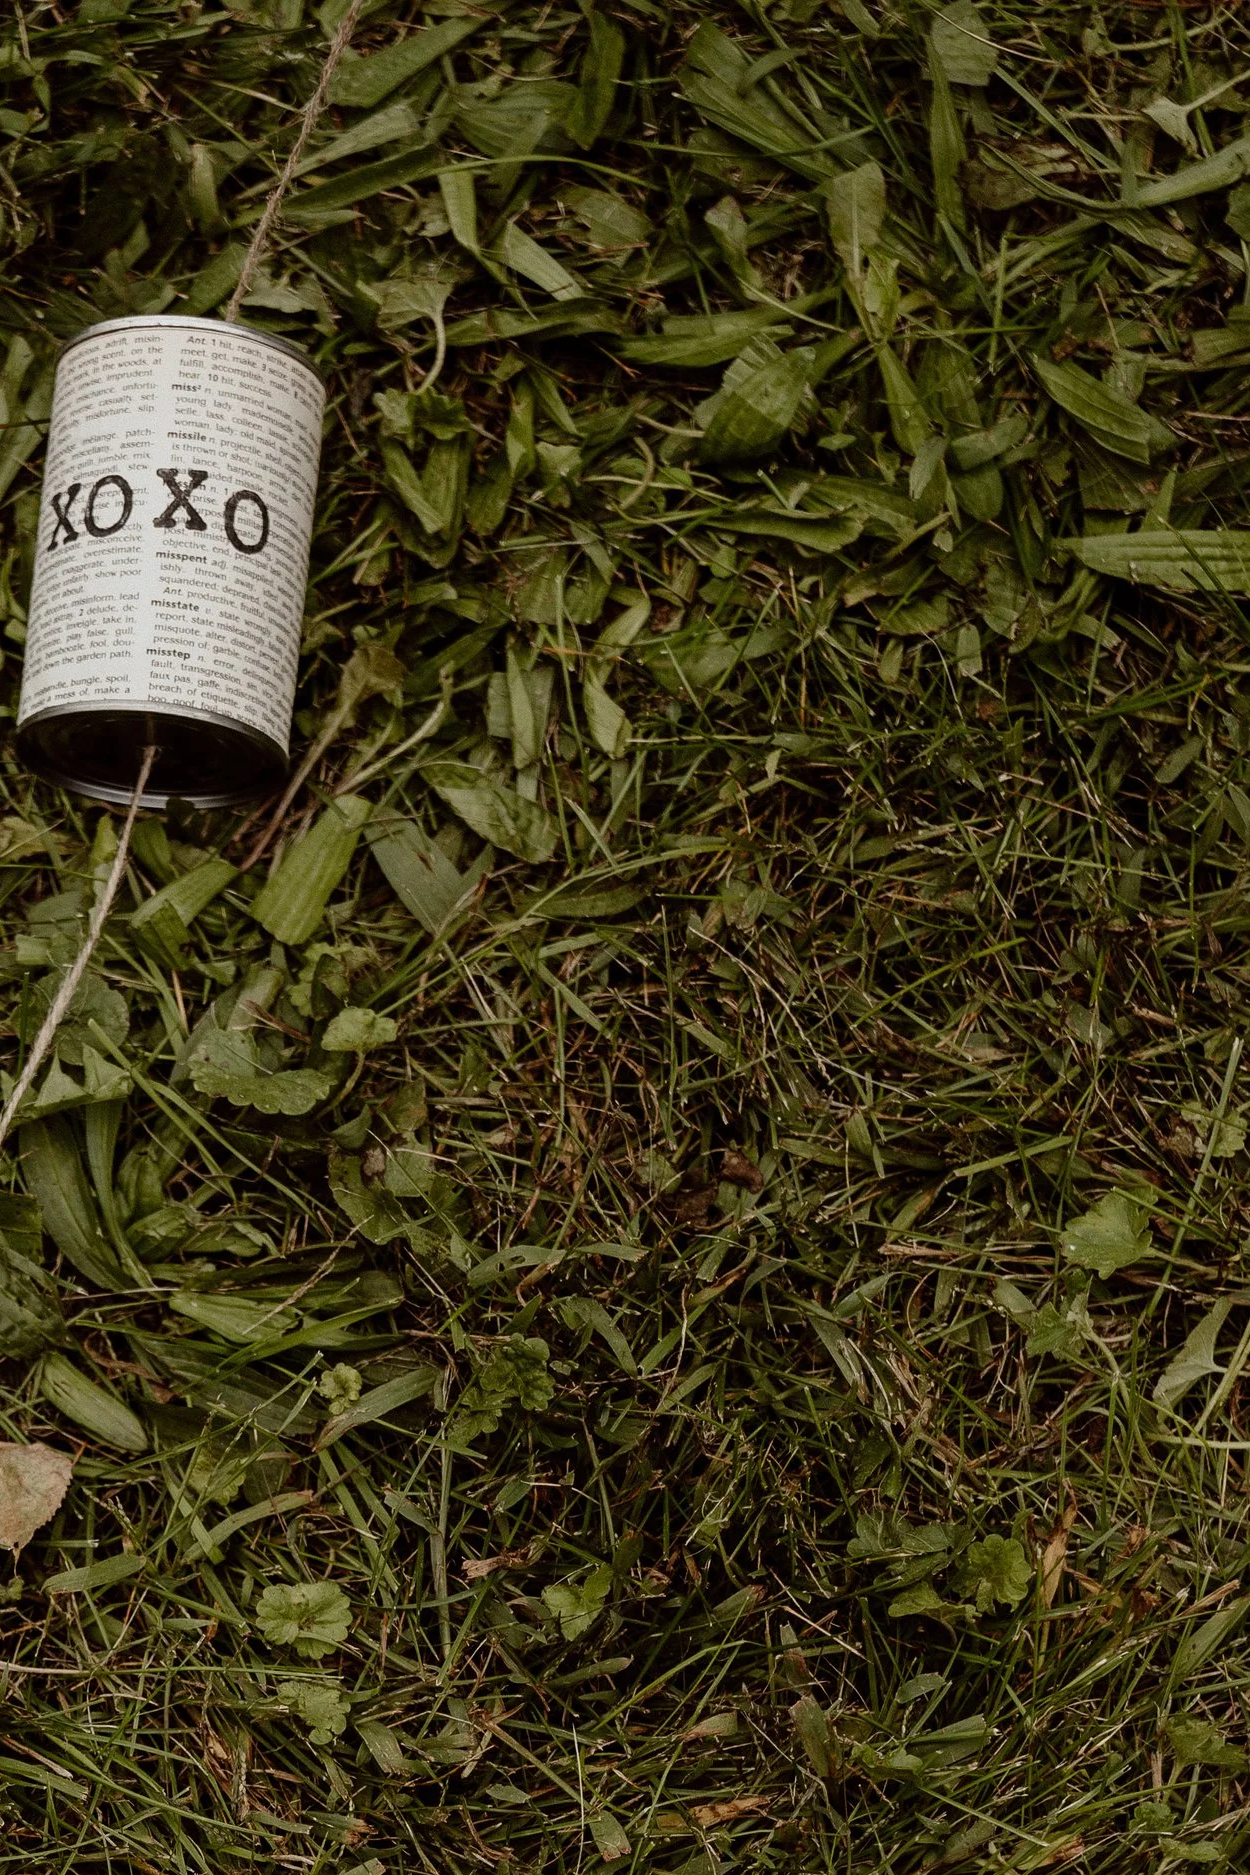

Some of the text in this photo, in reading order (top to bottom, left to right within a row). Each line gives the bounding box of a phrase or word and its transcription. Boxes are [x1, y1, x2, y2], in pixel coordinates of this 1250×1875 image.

[167, 430, 207, 442] missile
[182, 444, 216, 456] thrown
[155, 550, 207, 564] misspent
[151, 598, 199, 612] misstate
[146, 648, 190, 660] misstep
[94, 687, 120, 695] make
